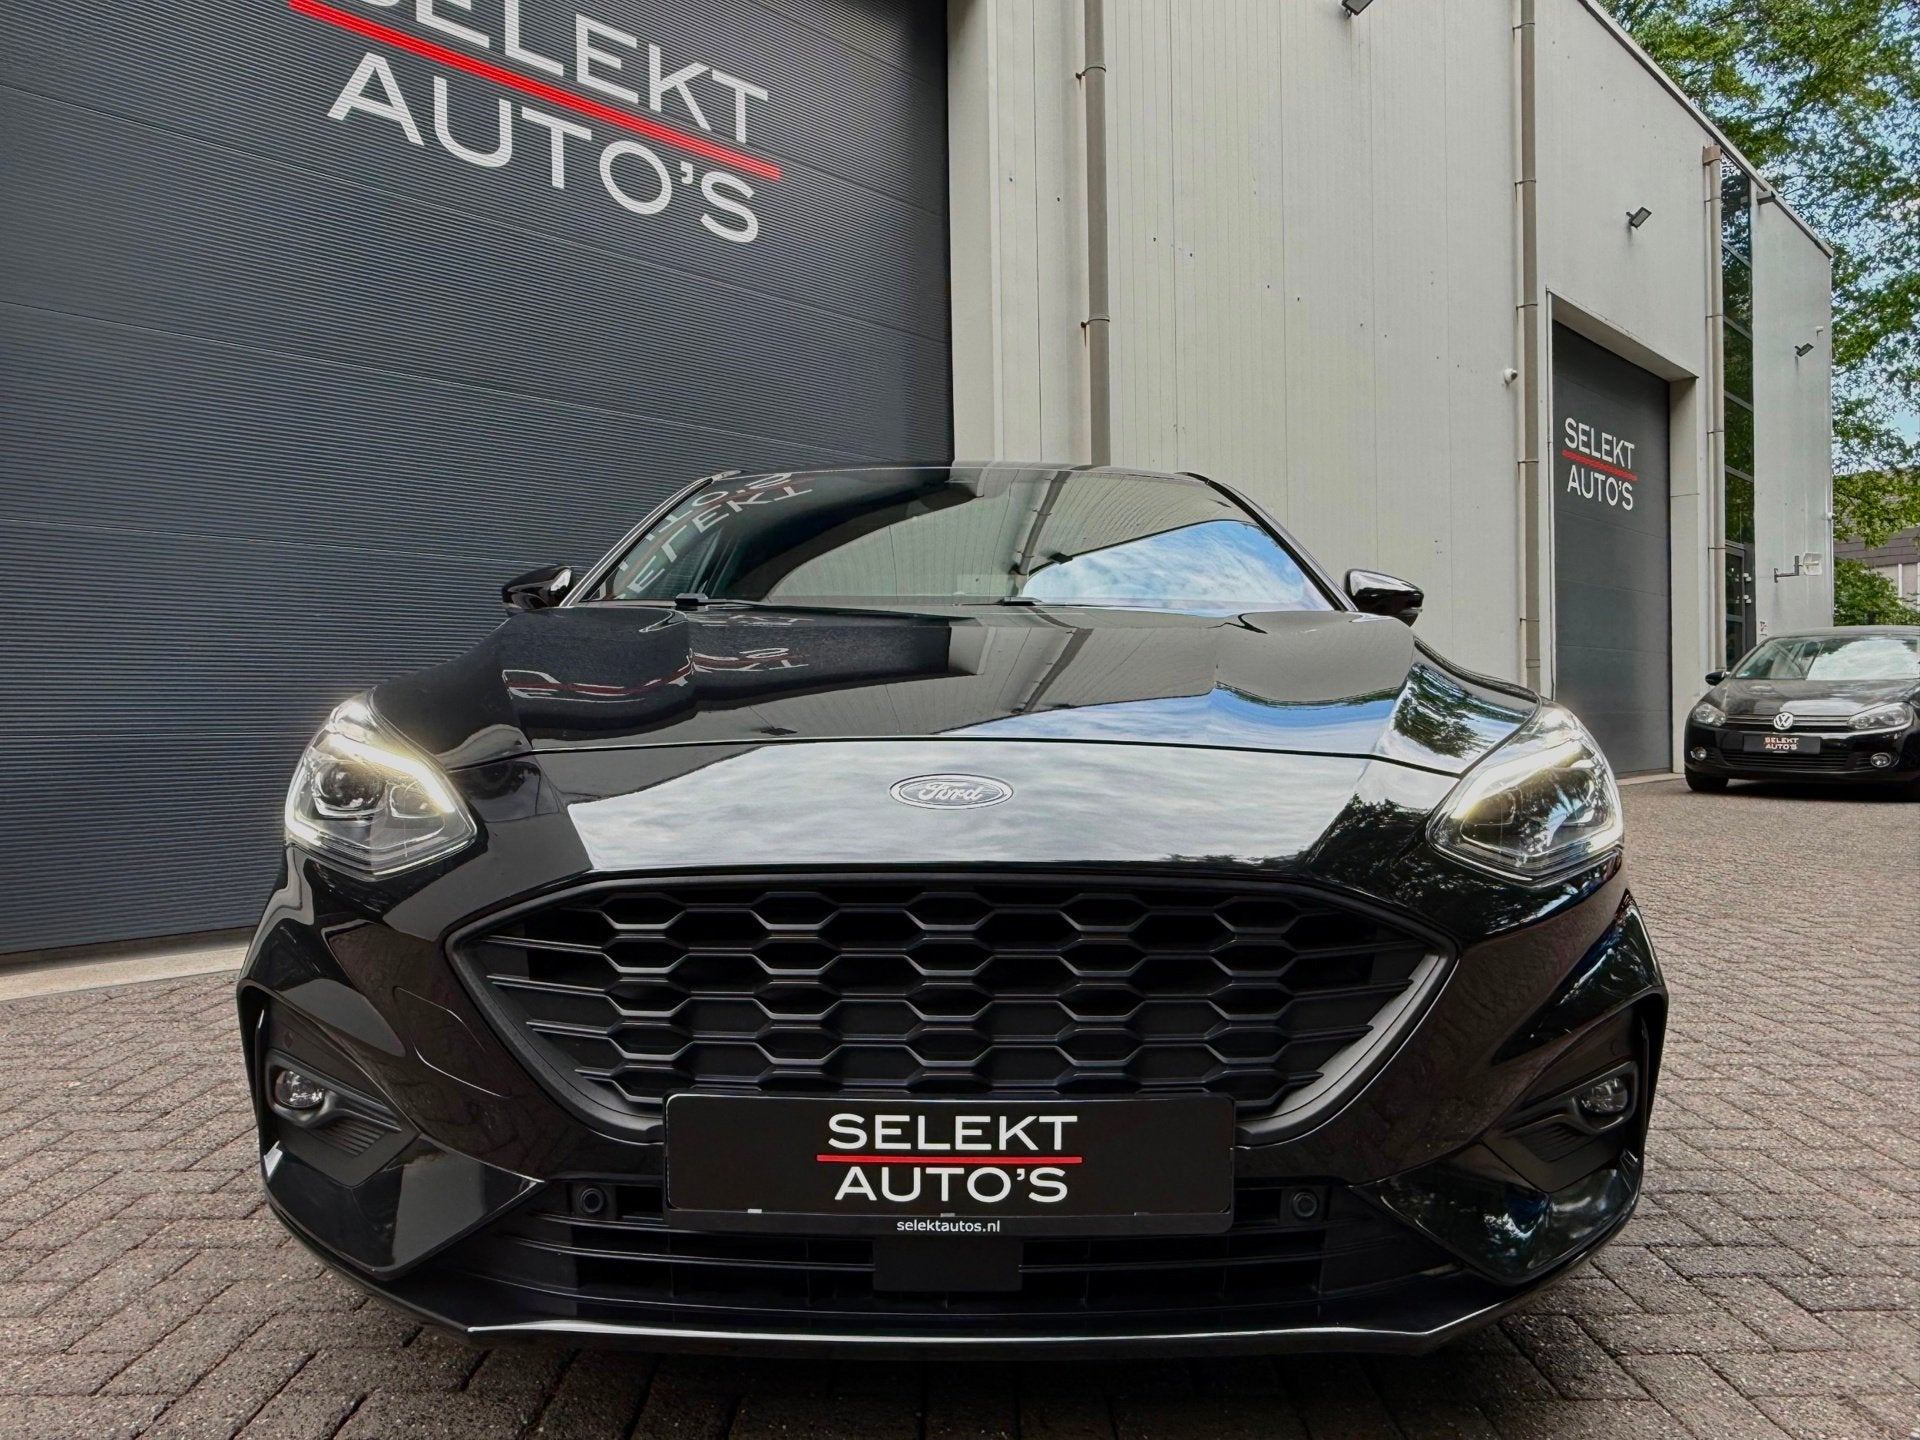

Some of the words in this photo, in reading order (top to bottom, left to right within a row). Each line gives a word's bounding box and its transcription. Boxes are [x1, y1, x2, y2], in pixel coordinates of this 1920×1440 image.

[361, 0, 769, 144] ELEKT
[327, 51, 759, 244] AUTO'S
[1564, 417, 1635, 470] SELEKT
[1567, 464, 1634, 511] AUTO'S
[918, 780, 983, 801] Ford
[828, 1112, 1078, 1152] SELEKT
[834, 1166, 1068, 1203] AUTO'S
[896, 1218, 1001, 1233] selektautos.nl
